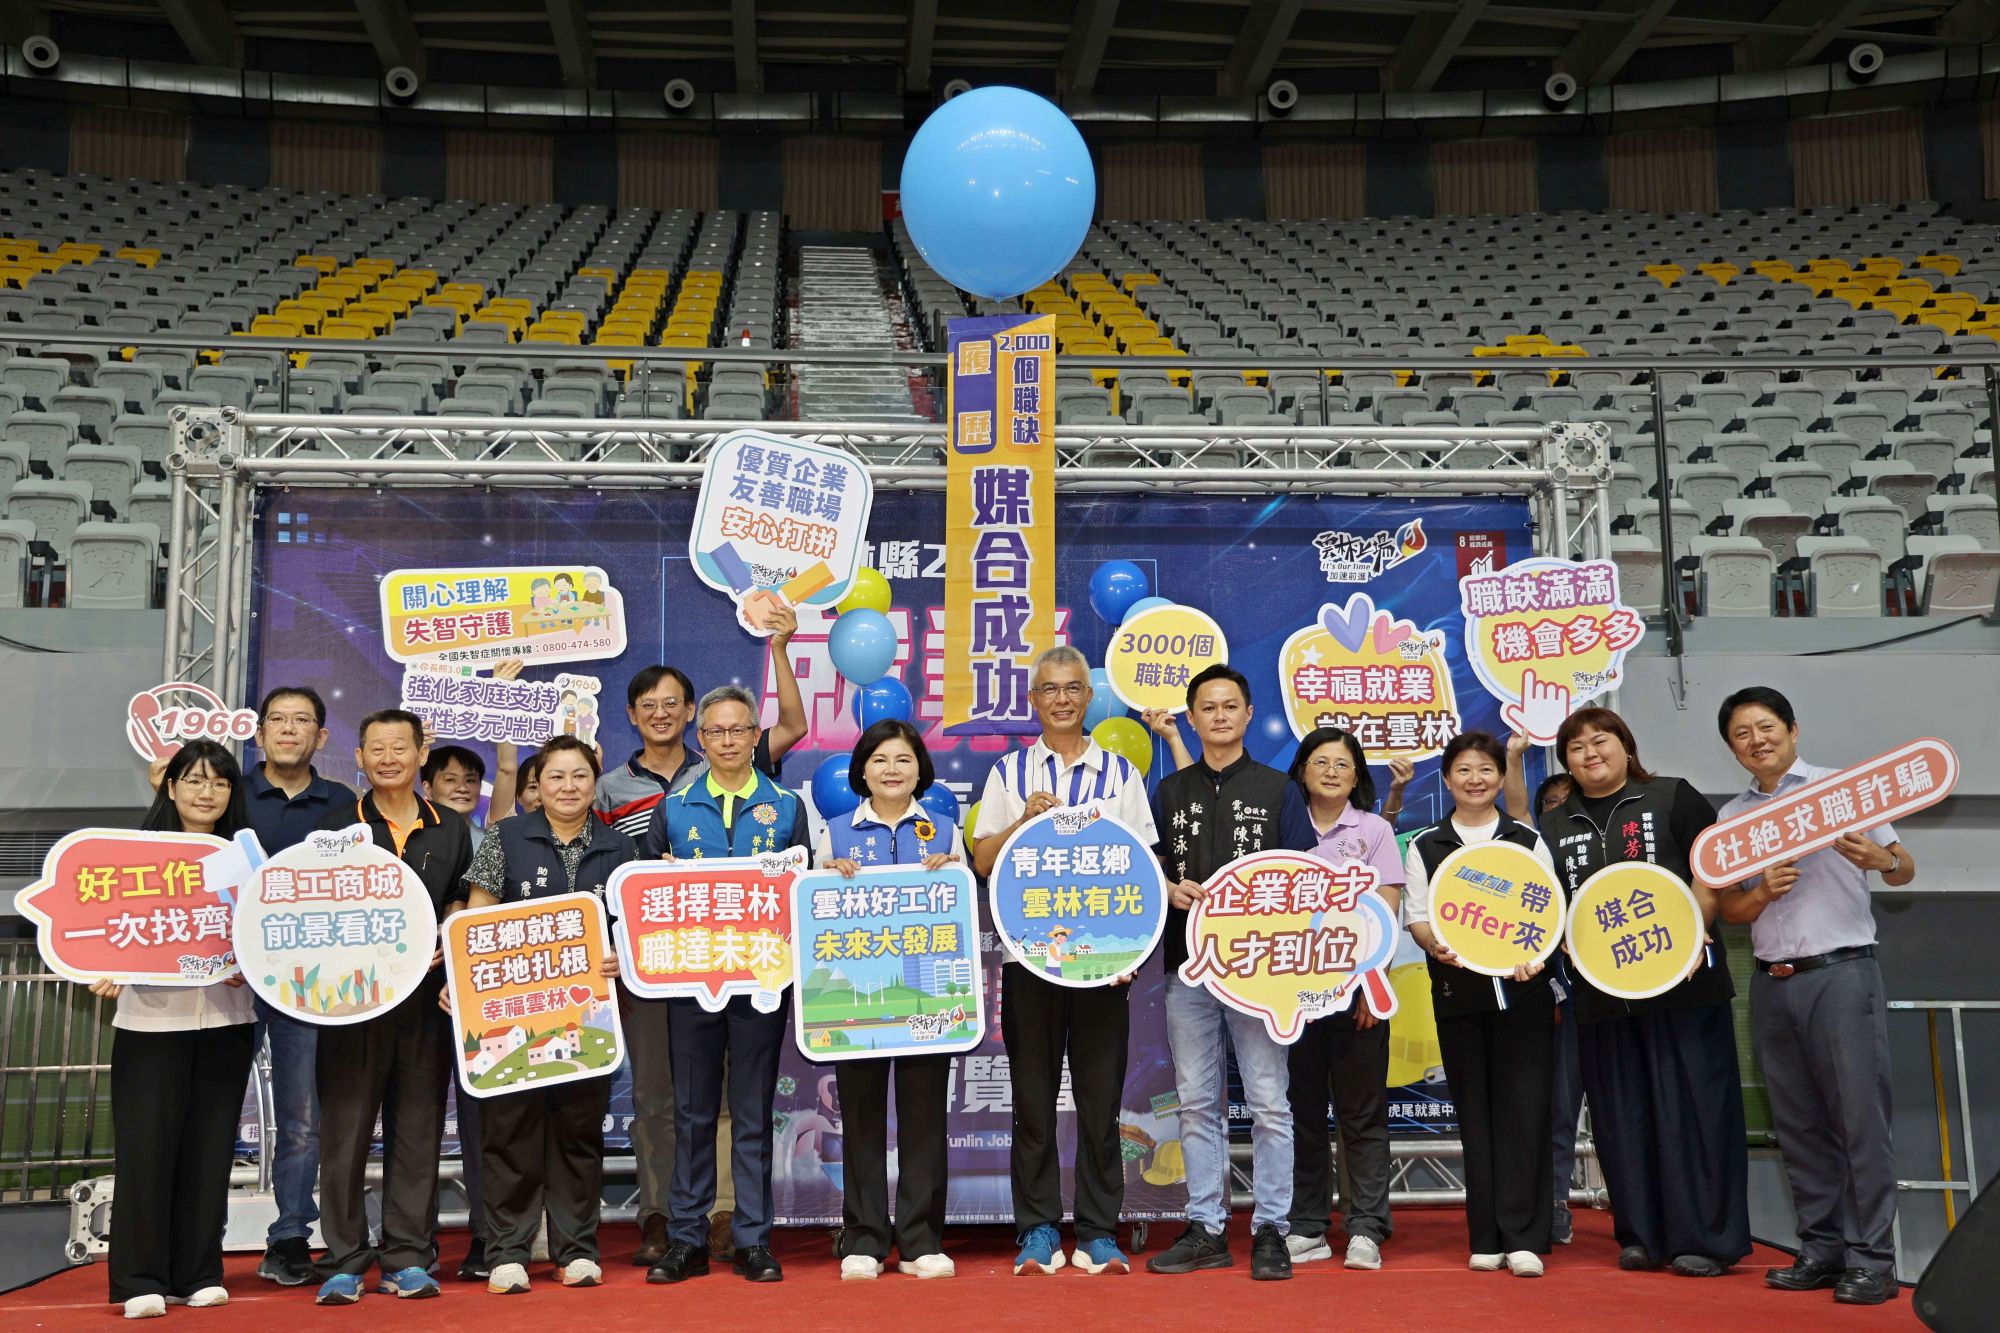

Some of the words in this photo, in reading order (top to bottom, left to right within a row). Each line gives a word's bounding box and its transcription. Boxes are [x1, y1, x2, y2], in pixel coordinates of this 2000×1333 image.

[999, 335, 1051, 353] 2,000
[957, 341, 991, 446] 履歷
[1012, 356, 1041, 445] 個職缺
[737, 443, 849, 493] 優質企業
[729, 473, 842, 522] 友善職場
[721, 507, 838, 559] 安心打拼
[1458, 535, 1466, 547] 8
[1352, 563, 1371, 571] Time
[403, 578, 509, 611] 關心理解
[971, 465, 1032, 720] 媒合成功
[1467, 564, 1614, 617] 職缺滿滿
[406, 612, 514, 645] 失智守護
[1120, 633, 1215, 658] 3000個
[1492, 611, 1641, 662] 機會多多
[407, 674, 560, 714] 強化家庭支持
[571, 678, 598, 692] 1966
[1134, 662, 1191, 689] 職缺
[1294, 664, 1434, 704] 幸福就業
[157, 708, 256, 739] 1966
[1714, 756, 1935, 871] 杜絕求職詐騙
[77, 860, 202, 903] 好工作
[536, 866, 548, 887] 助理
[1011, 845, 1131, 878] 青年返鄉
[261, 865, 402, 901] 農工商城
[640, 882, 781, 923] 選擇雲林
[812, 883, 957, 919] 雲林好工作
[1022, 884, 1143, 918] 雲林有光
[1205, 867, 1374, 917] 企業徵才
[64, 905, 232, 947] 一次找齊
[263, 909, 405, 950] 前景看好
[1595, 889, 1657, 934] 媒合
[467, 909, 584, 956] 返鄉就業
[639, 927, 782, 974] 職達未來
[814, 925, 959, 962] 未來大發展
[1610, 925, 1674, 969] 成功
[471, 946, 590, 993] 在地扎根
[1188, 928, 1358, 979] 人才到位
[482, 987, 569, 1021] 幸福雲林
[1388, 1103, 1457, 1119] 虎尾就業中
[947, 1134, 984, 1148] unlin
